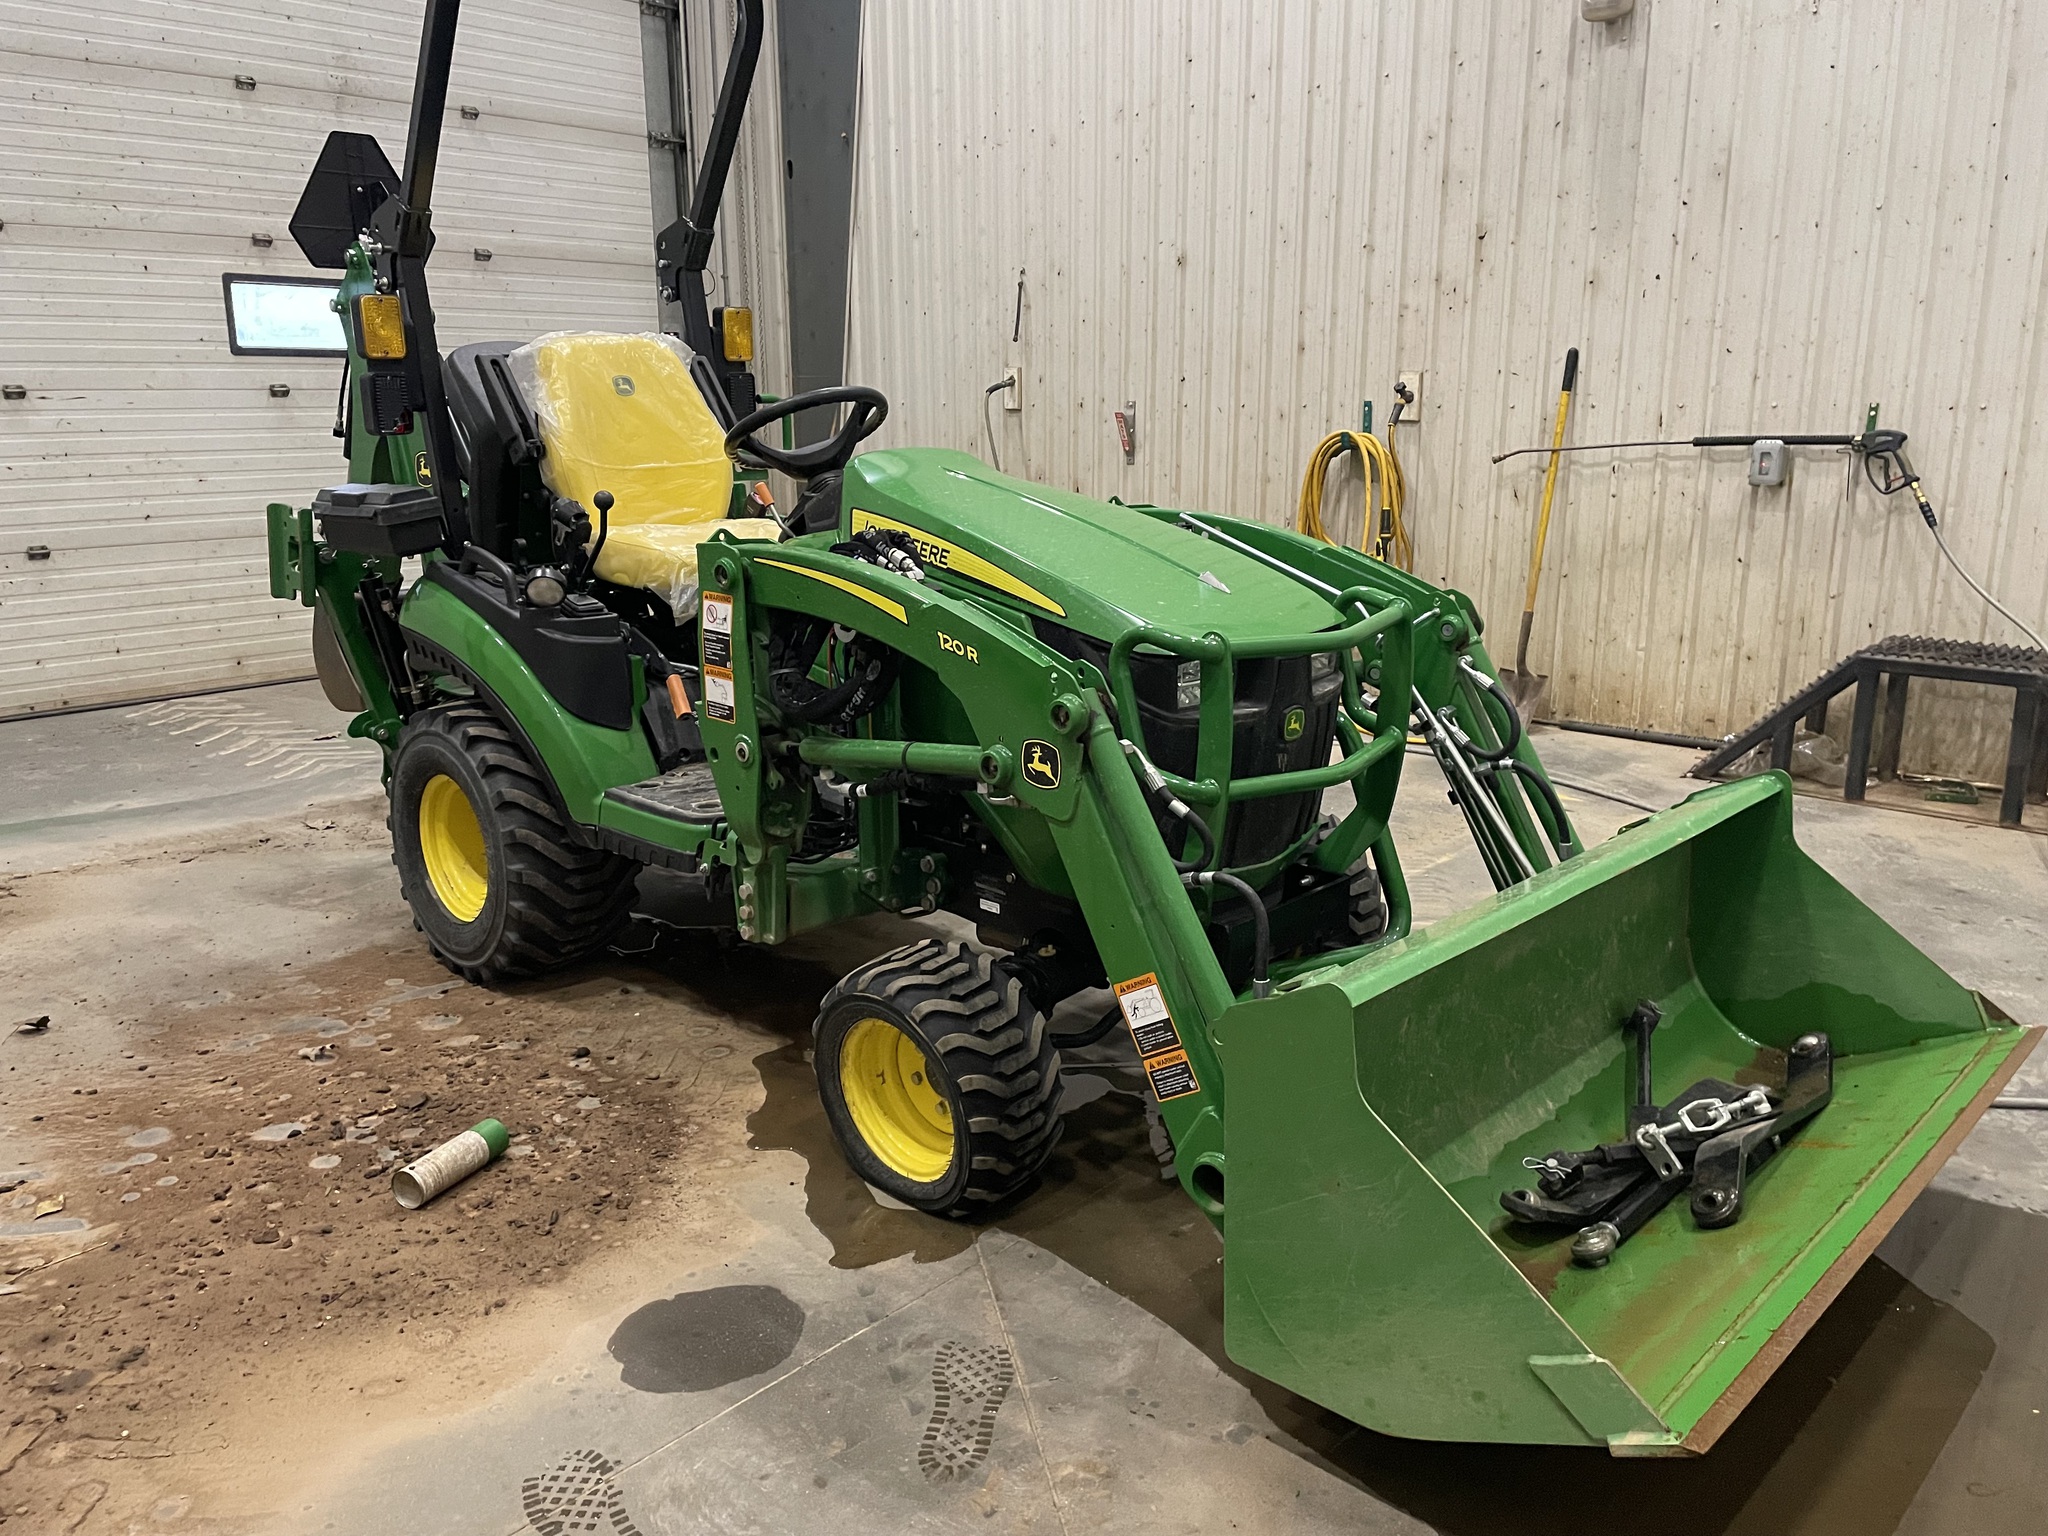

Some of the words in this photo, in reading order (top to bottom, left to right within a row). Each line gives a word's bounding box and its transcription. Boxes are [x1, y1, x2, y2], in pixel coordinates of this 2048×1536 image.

[709, 593, 732, 604] WARNING
[709, 668, 732, 680] WARNING
[1126, 977, 1152, 990] WARNING
[1156, 1054, 1183, 1067] WARNING
